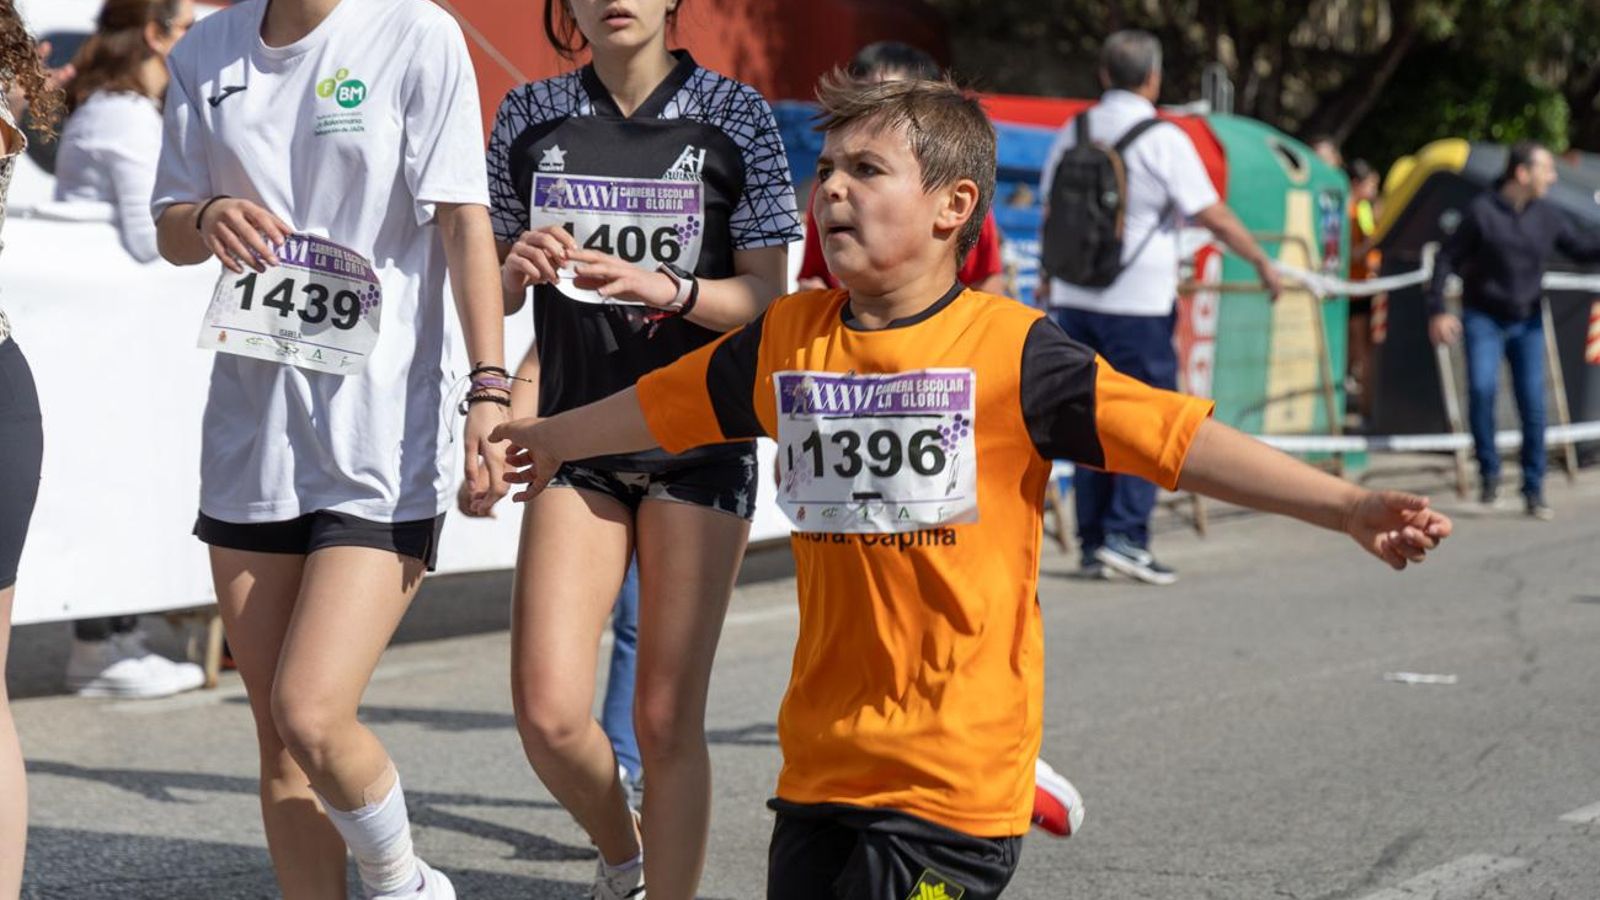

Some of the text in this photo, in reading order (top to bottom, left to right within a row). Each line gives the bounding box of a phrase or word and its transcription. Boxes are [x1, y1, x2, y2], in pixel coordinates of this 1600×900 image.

[339, 85, 363, 101] BM
[564, 183, 695, 208] XXXVI CARRERA ESCOLAR
[626, 199, 684, 211] LA GLORIA
[314, 254, 327, 268] LA
[334, 259, 367, 278] GLORIA
[234, 272, 361, 330] 1439
[809, 379, 964, 411] XXXVI CARRERA ESCOLAR
[877, 393, 950, 409] LA GLORIA
[802, 429, 946, 479] 1396
